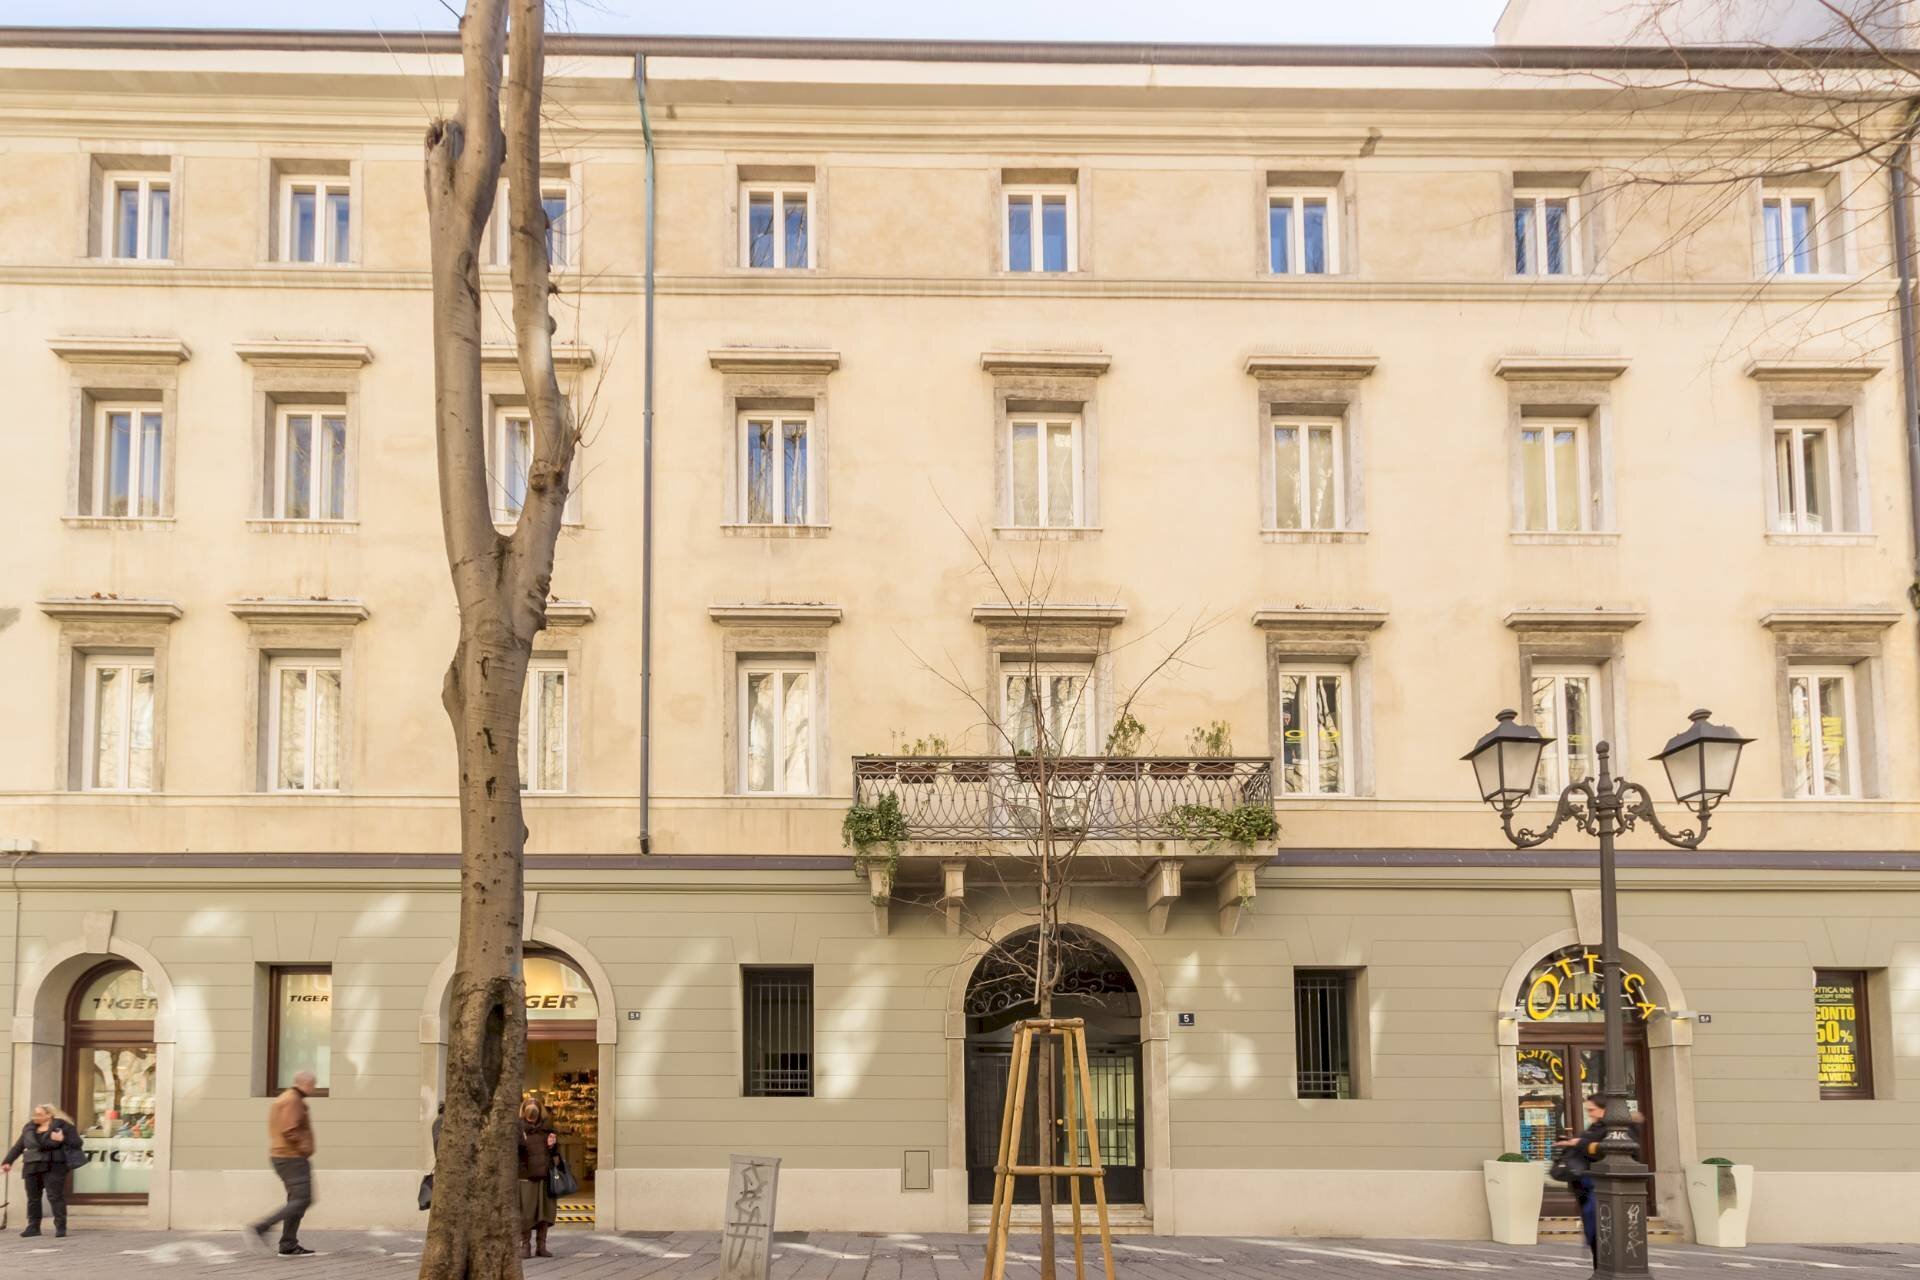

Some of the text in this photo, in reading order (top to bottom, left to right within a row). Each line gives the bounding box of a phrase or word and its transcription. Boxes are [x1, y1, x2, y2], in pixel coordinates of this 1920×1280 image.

[1526, 953, 1656, 1021] OTTCA
[93, 998, 159, 1010] TIGER
[525, 994, 578, 1009] GER
[1815, 1006, 1856, 1020] CONTO
